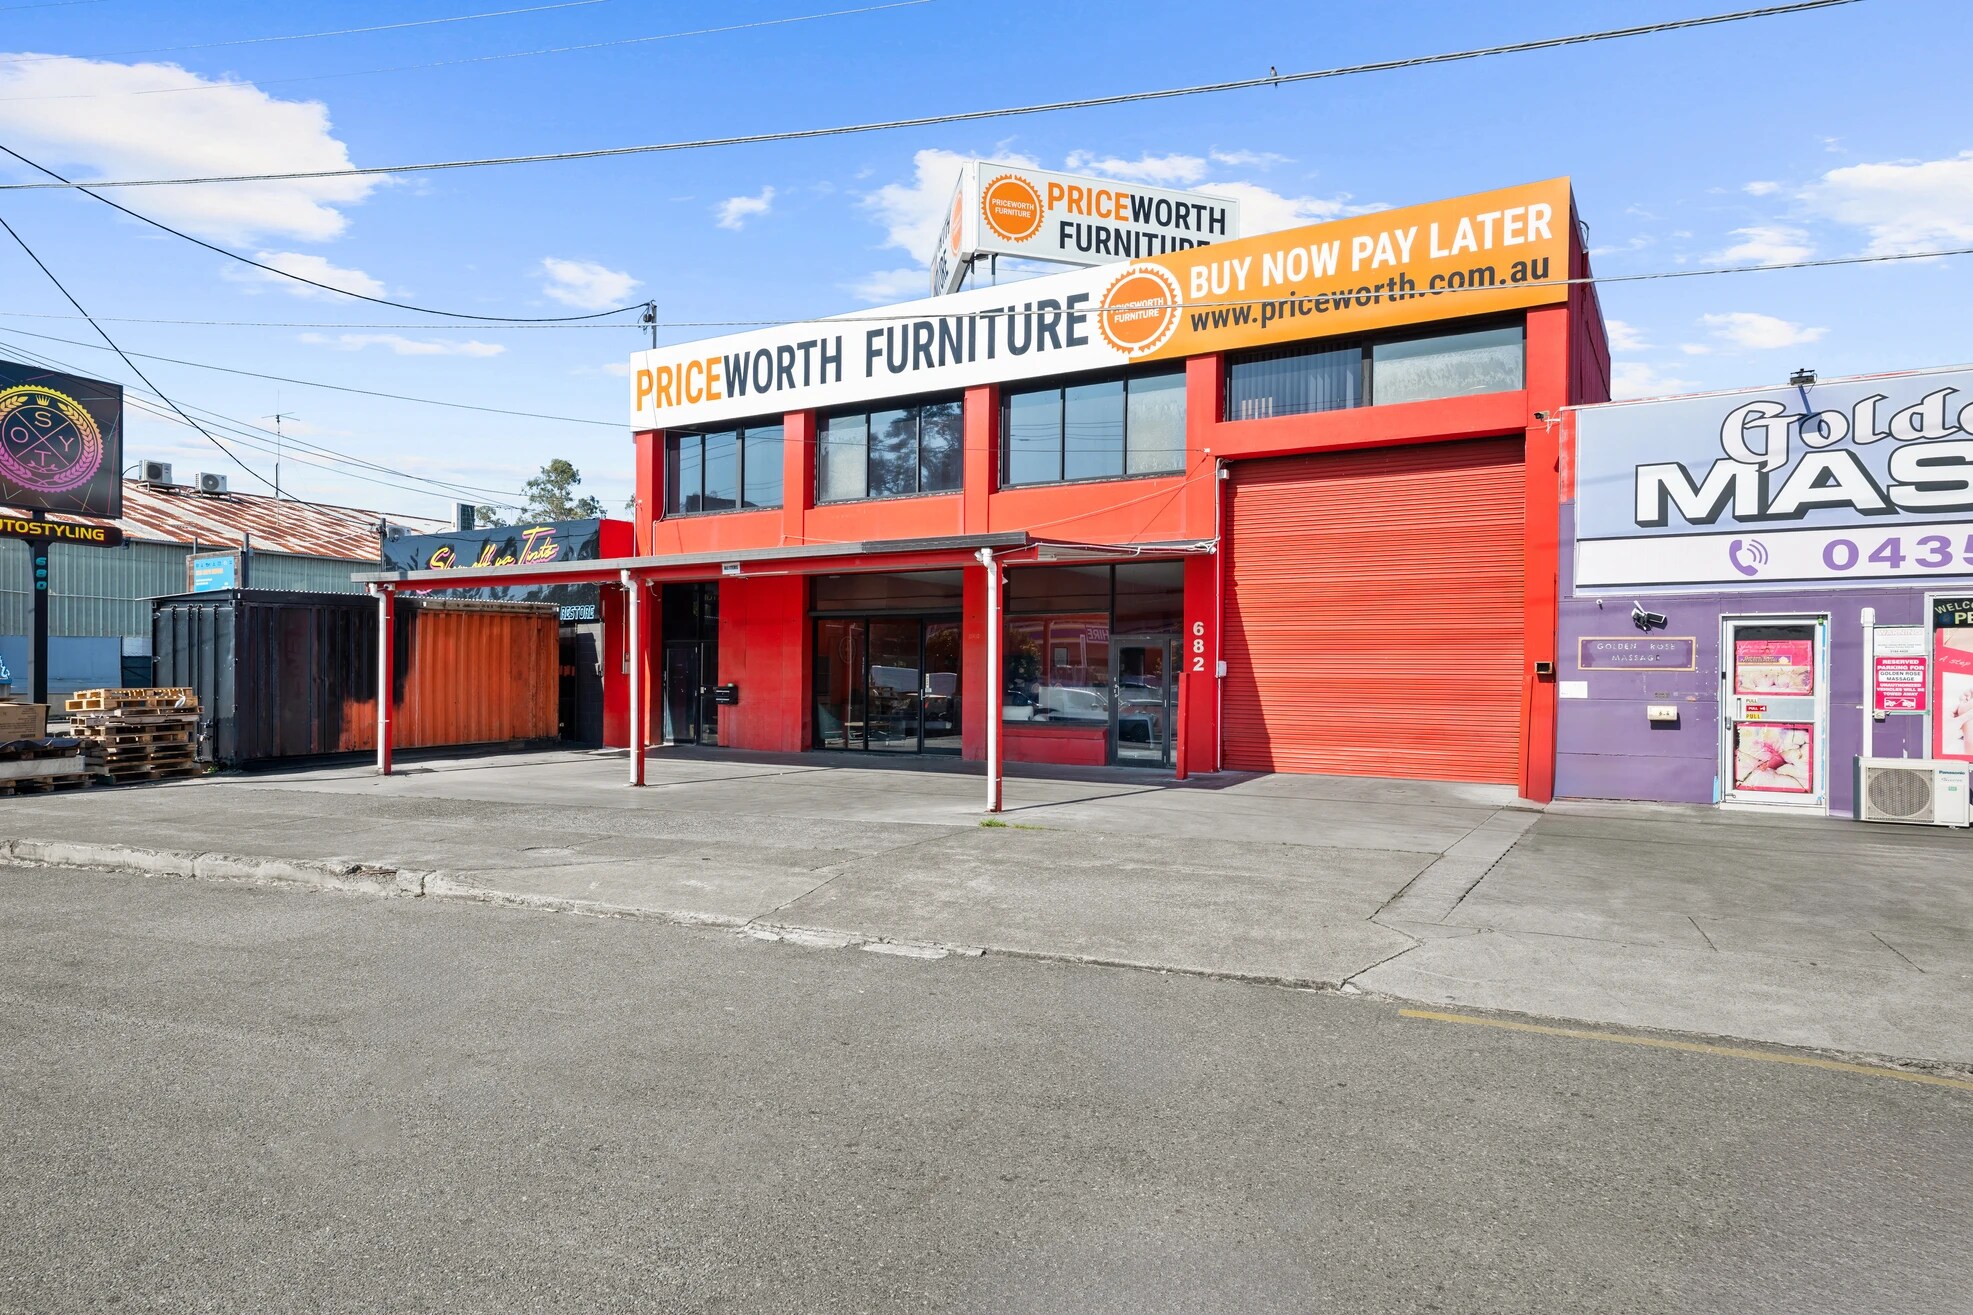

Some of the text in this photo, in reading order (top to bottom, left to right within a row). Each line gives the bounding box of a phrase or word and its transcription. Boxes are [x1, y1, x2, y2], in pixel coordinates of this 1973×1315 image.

[992, 198, 1035, 211] PRICEWORTH
[995, 207, 1031, 218] FURNITURE
[1047, 181, 1226, 236] PRICEWORTH
[1190, 203, 1553, 299] BUY NOW PAY LATER
[1191, 256, 1550, 333] www.priceworth.com.au
[1114, 309, 1160, 323] FURNITURE
[636, 292, 1090, 411] PRICEWORTH FURNITURE
[0, 518, 105, 541] TOSTYLING
[560, 605, 595, 620] RESTORE
[1192, 621, 1205, 672] 682
